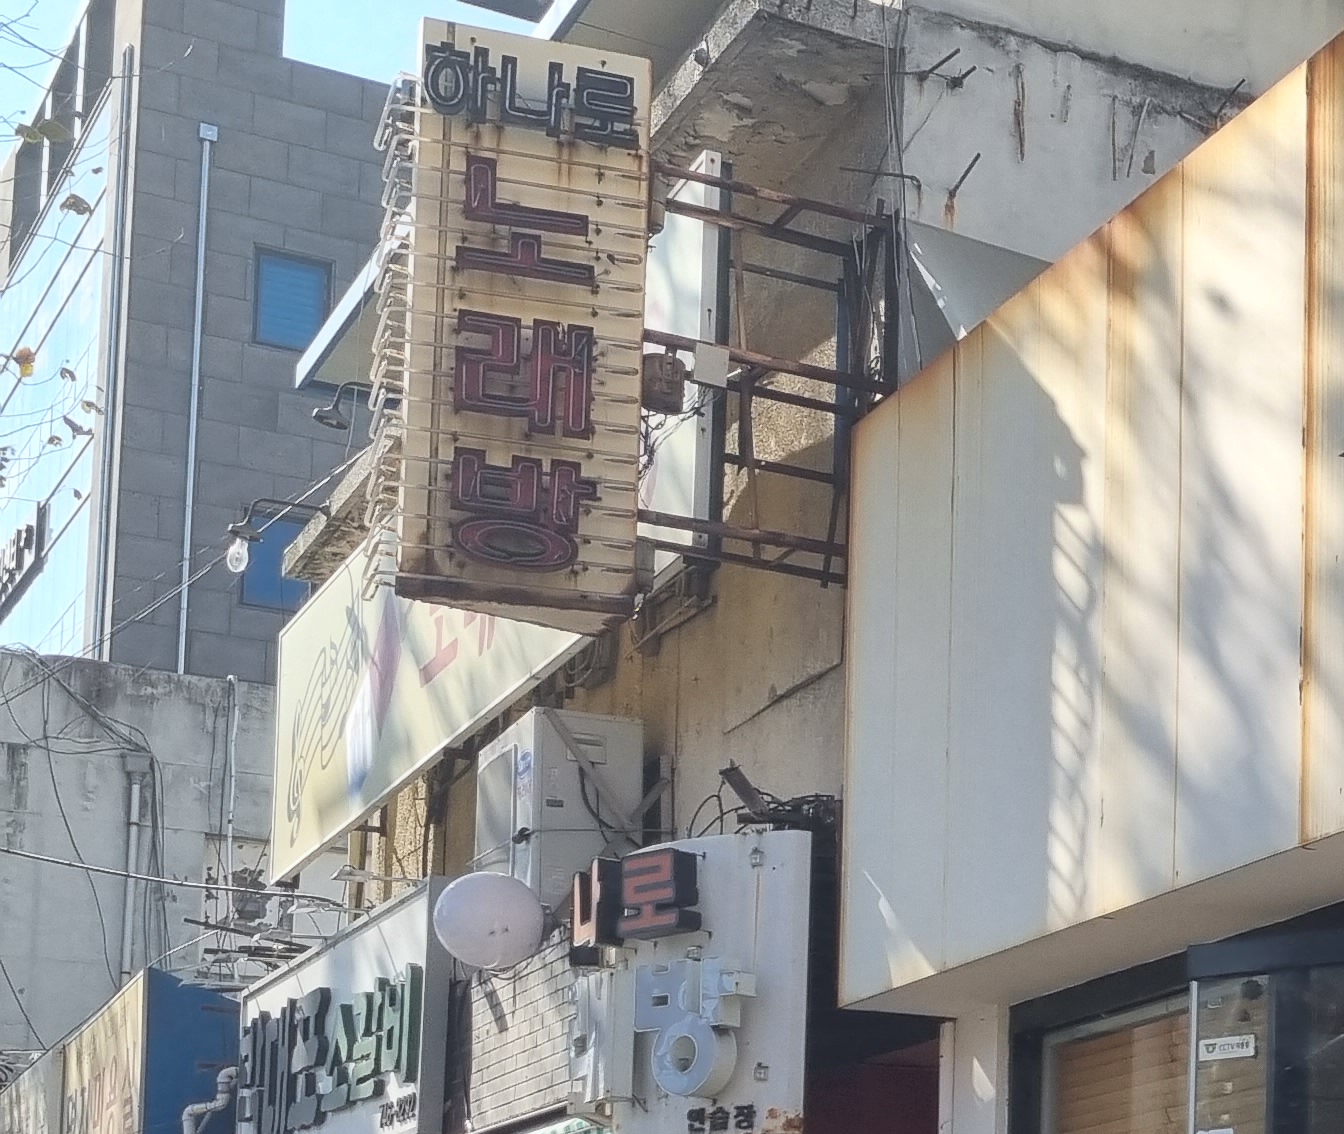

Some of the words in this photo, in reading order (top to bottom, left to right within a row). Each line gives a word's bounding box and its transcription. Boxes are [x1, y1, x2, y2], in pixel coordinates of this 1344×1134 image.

[424, 40, 640, 150] 하나로
[450, 156, 598, 573] 노래방
[686, 1103, 756, 1133] 연습장
